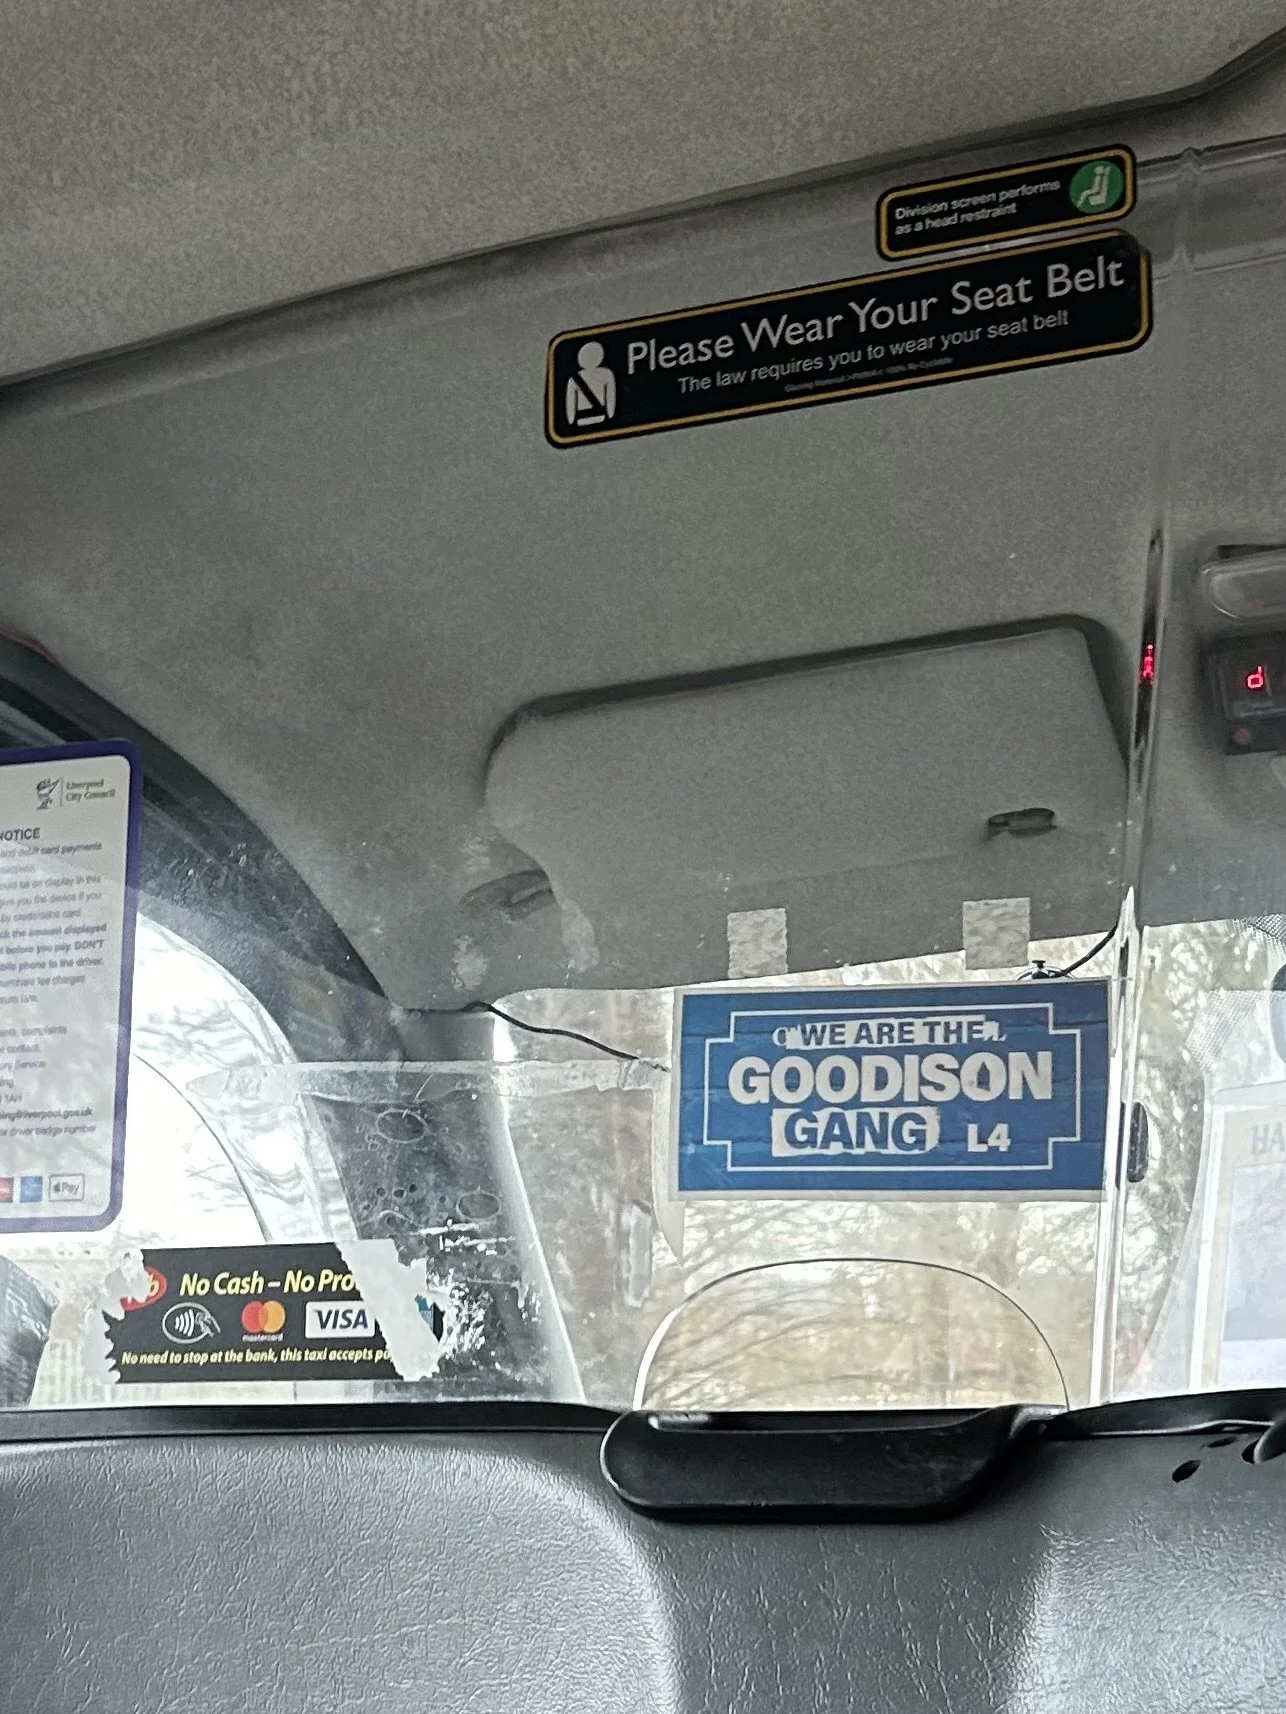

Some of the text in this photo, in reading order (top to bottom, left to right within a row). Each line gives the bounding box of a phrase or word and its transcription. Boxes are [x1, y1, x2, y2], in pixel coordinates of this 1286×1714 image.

[895, 180, 1061, 220] Division screen performs
[895, 203, 1017, 235] as a head restraint
[627, 257, 1125, 375] Please Wear Your Seat Belt
[678, 374, 712, 394] The
[716, 368, 746, 388] law
[750, 356, 826, 385] requires
[829, 350, 863, 374] you
[866, 342, 886, 360] to
[889, 336, 936, 357] wear
[940, 327, 985, 352] your
[987, 318, 1030, 340] seat
[1033, 309, 1070, 331] belt
[66, 789, 116, 802] City Council
[61, 841, 103, 855] payments
[37, 944, 52, 954] you
[74, 939, 104, 951] DON'T
[800, 1022, 846, 1047] WE
[853, 1021, 914, 1045] ARE
[925, 1020, 986, 1045] THE
[728, 1051, 1053, 1104] GOODISON
[784, 1111, 1012, 1153] GANG L4
[61, 1181, 80, 1195] Pay
[180, 1273, 211, 1297] No
[214, 1269, 265, 1296] Cash
[284, 1270, 315, 1294] No
[318, 1269, 358, 1293] Pro
[315, 1308, 369, 1330] VISA
[242, 1333, 284, 1342] mastercard
[121, 1348, 392, 1366] No need to stop at the bank, this taxi accepts pa
